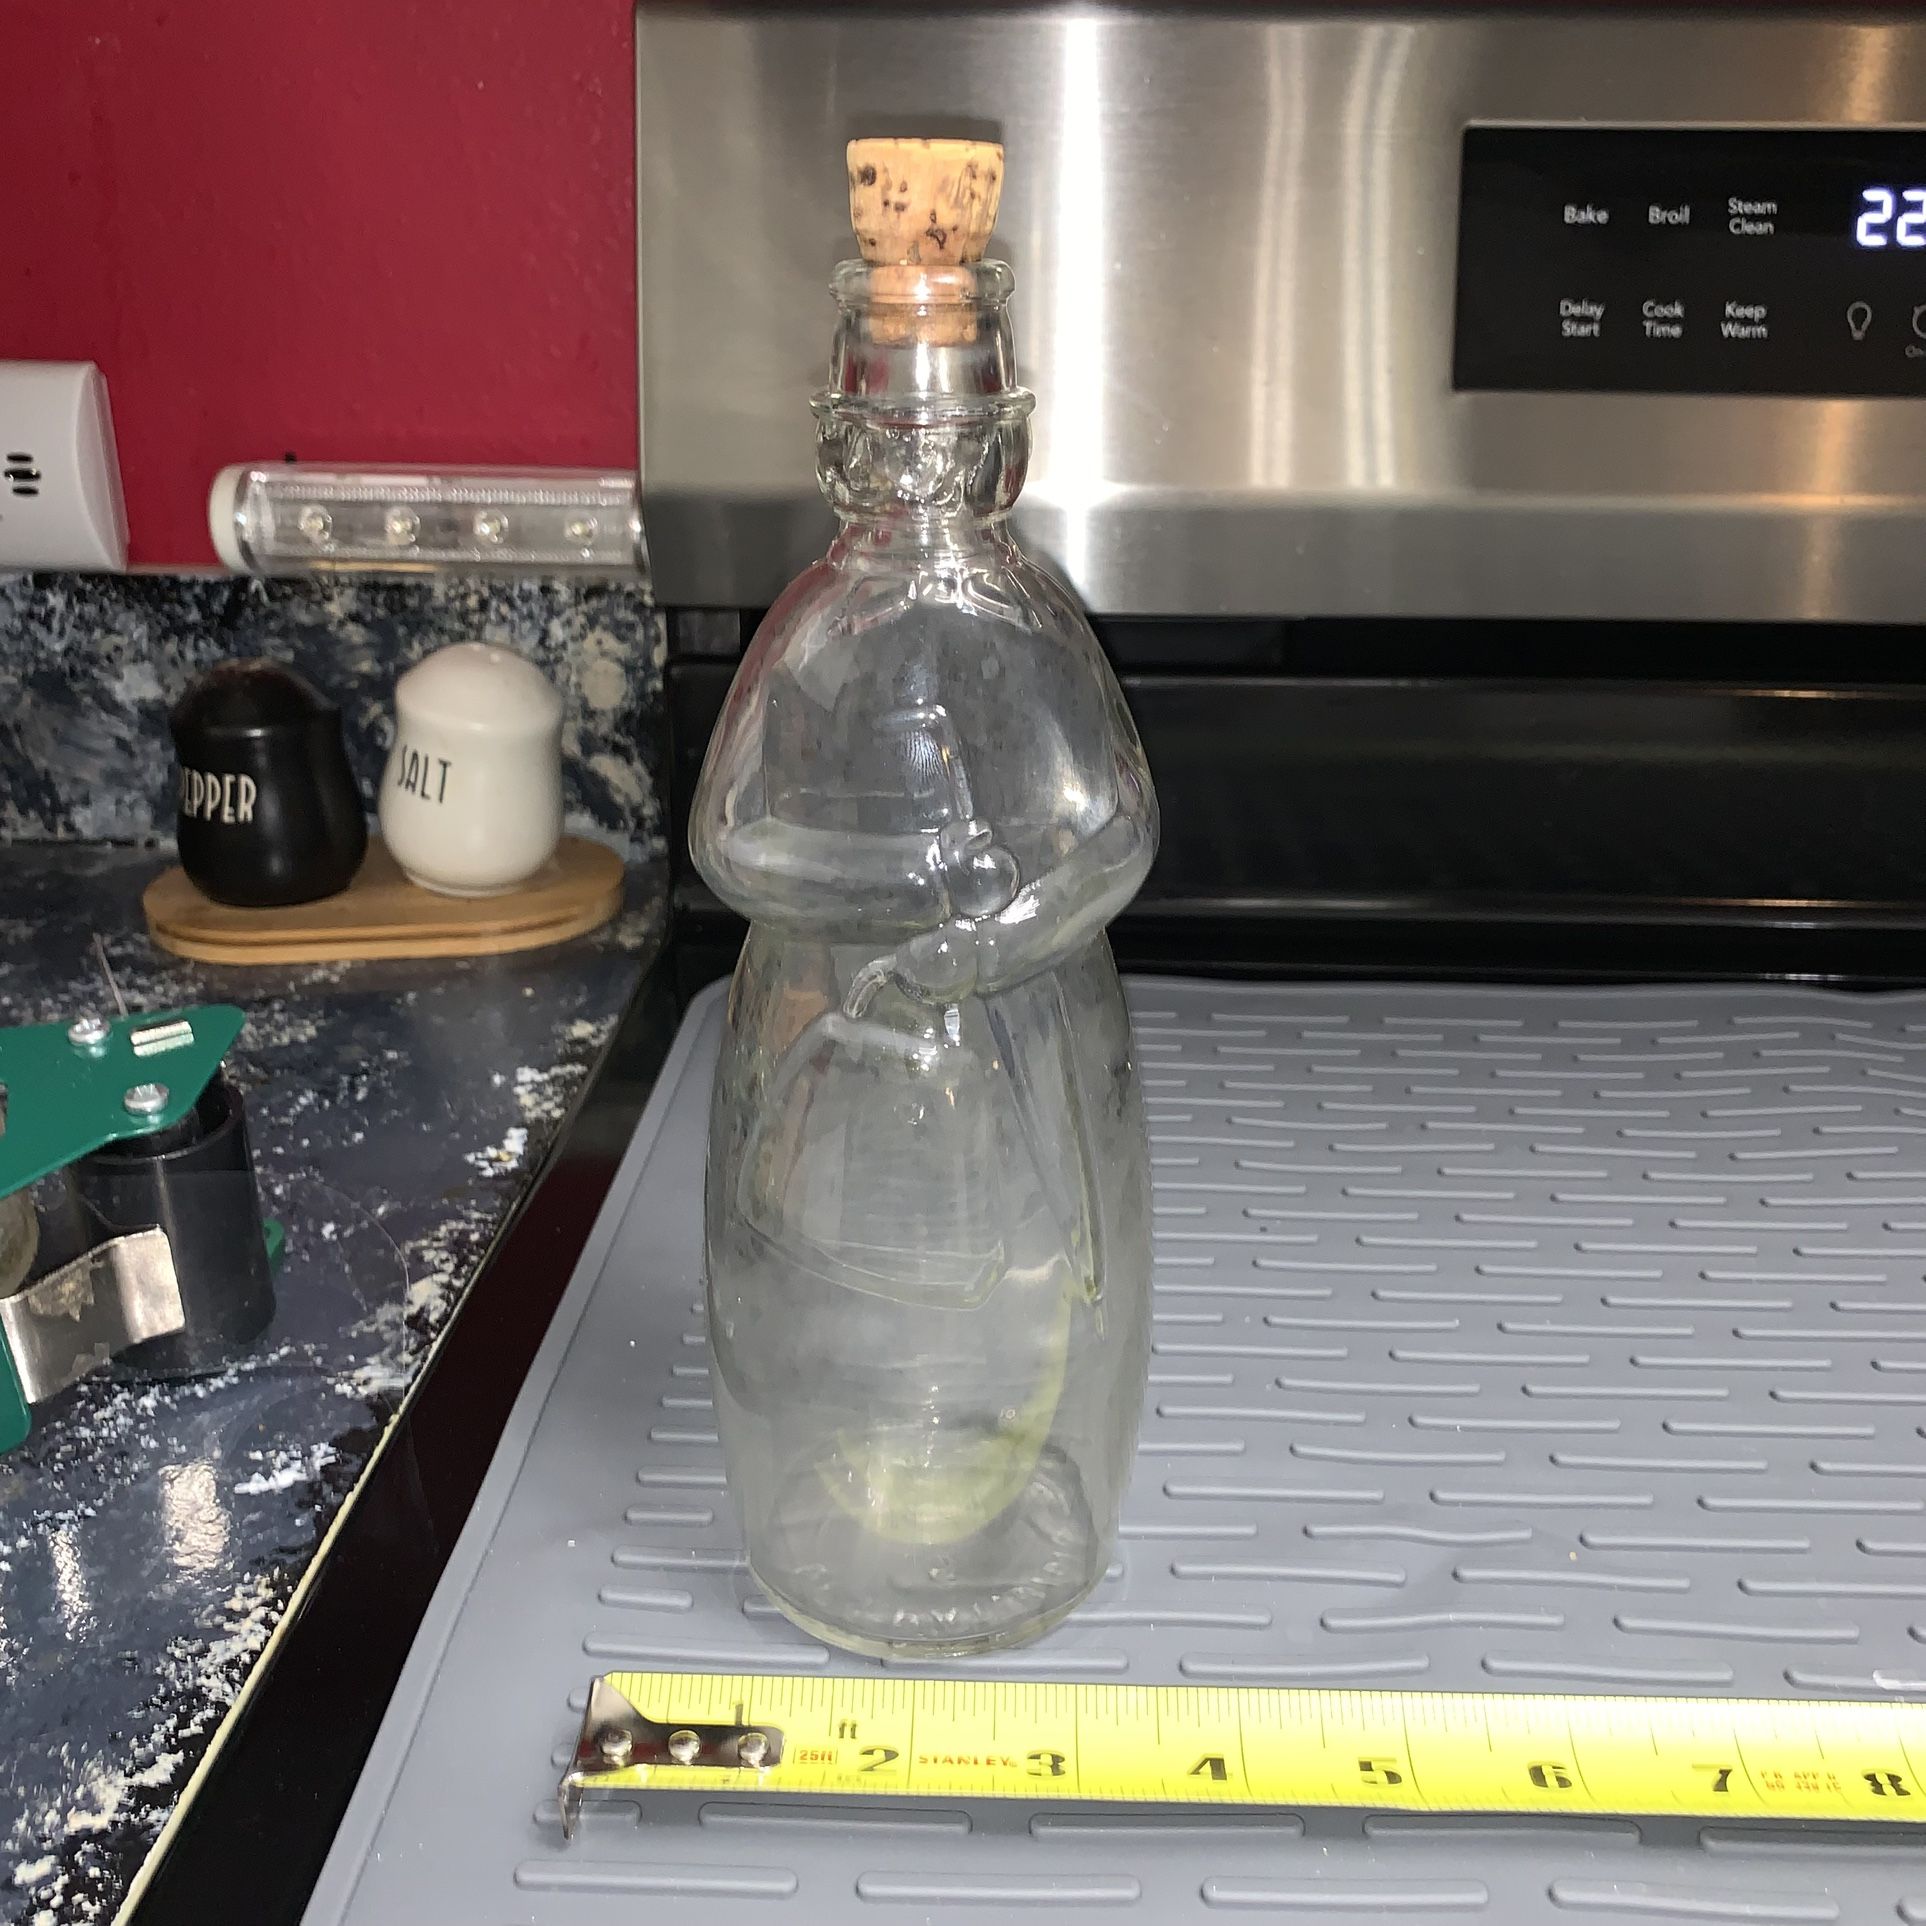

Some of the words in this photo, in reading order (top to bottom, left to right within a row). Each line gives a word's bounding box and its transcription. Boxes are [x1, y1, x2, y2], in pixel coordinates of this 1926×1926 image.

[1563, 204, 1610, 225] Bake
[1648, 204, 1691, 225] Broil
[1727, 197, 1778, 216] Steam
[1856, 188, 1926, 246] 22
[1728, 217, 1775, 236] Clean
[1559, 299, 1605, 320] Delay
[1642, 300, 1685, 318] Cook
[1724, 301, 1767, 321] Keep
[1561, 319, 1601, 338] Start
[1642, 319, 1683, 338] Time
[1720, 321, 1768, 339] Warm
[397, 744, 452, 804] SALT
[181, 765, 257, 824] EPPER
[860, 1745, 899, 1774] 2
[1027, 1751, 1066, 1777] 3
[1187, 1754, 1228, 1781] 4
[1359, 1757, 1403, 1786] 5
[1528, 1762, 1573, 1789] 6
[1693, 1765, 1733, 1792] 7
[1862, 1769, 1911, 1797] 8
